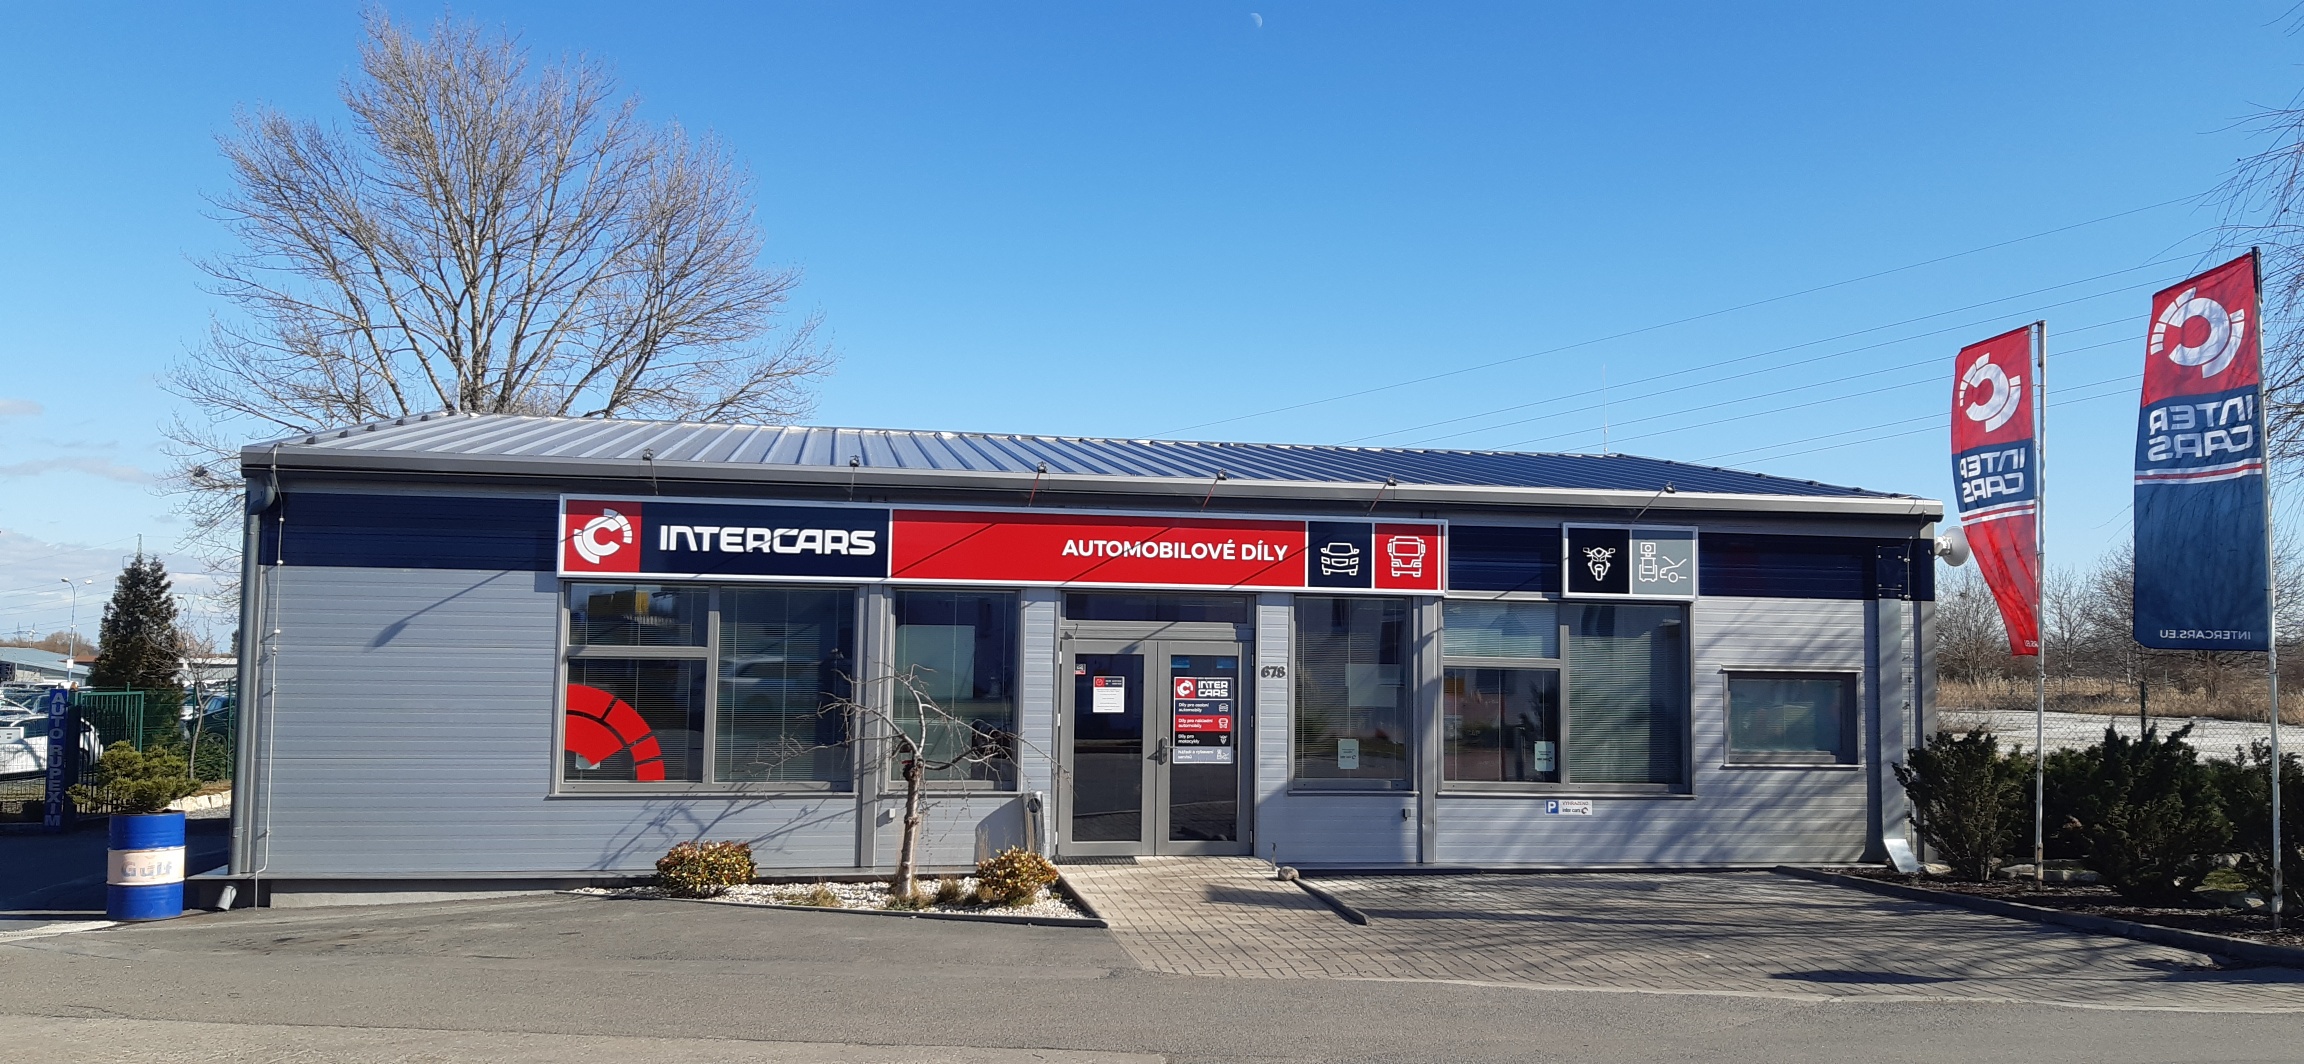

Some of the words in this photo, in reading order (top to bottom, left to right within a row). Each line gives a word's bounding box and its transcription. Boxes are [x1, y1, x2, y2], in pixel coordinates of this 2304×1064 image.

[659, 524, 877, 556] INTERCARS
[1061, 539, 1236, 560] AUTOMOBILOVÉ
[1241, 540, 1288, 562] DÍLY
[1260, 665, 1286, 678] 678
[1198, 681, 1228, 689] INTER
[1198, 689, 1228, 697] CARS
[50, 692, 66, 740] AUTO
[45, 745, 63, 827] RUPEXIM
[1548, 802, 1556, 812] P
